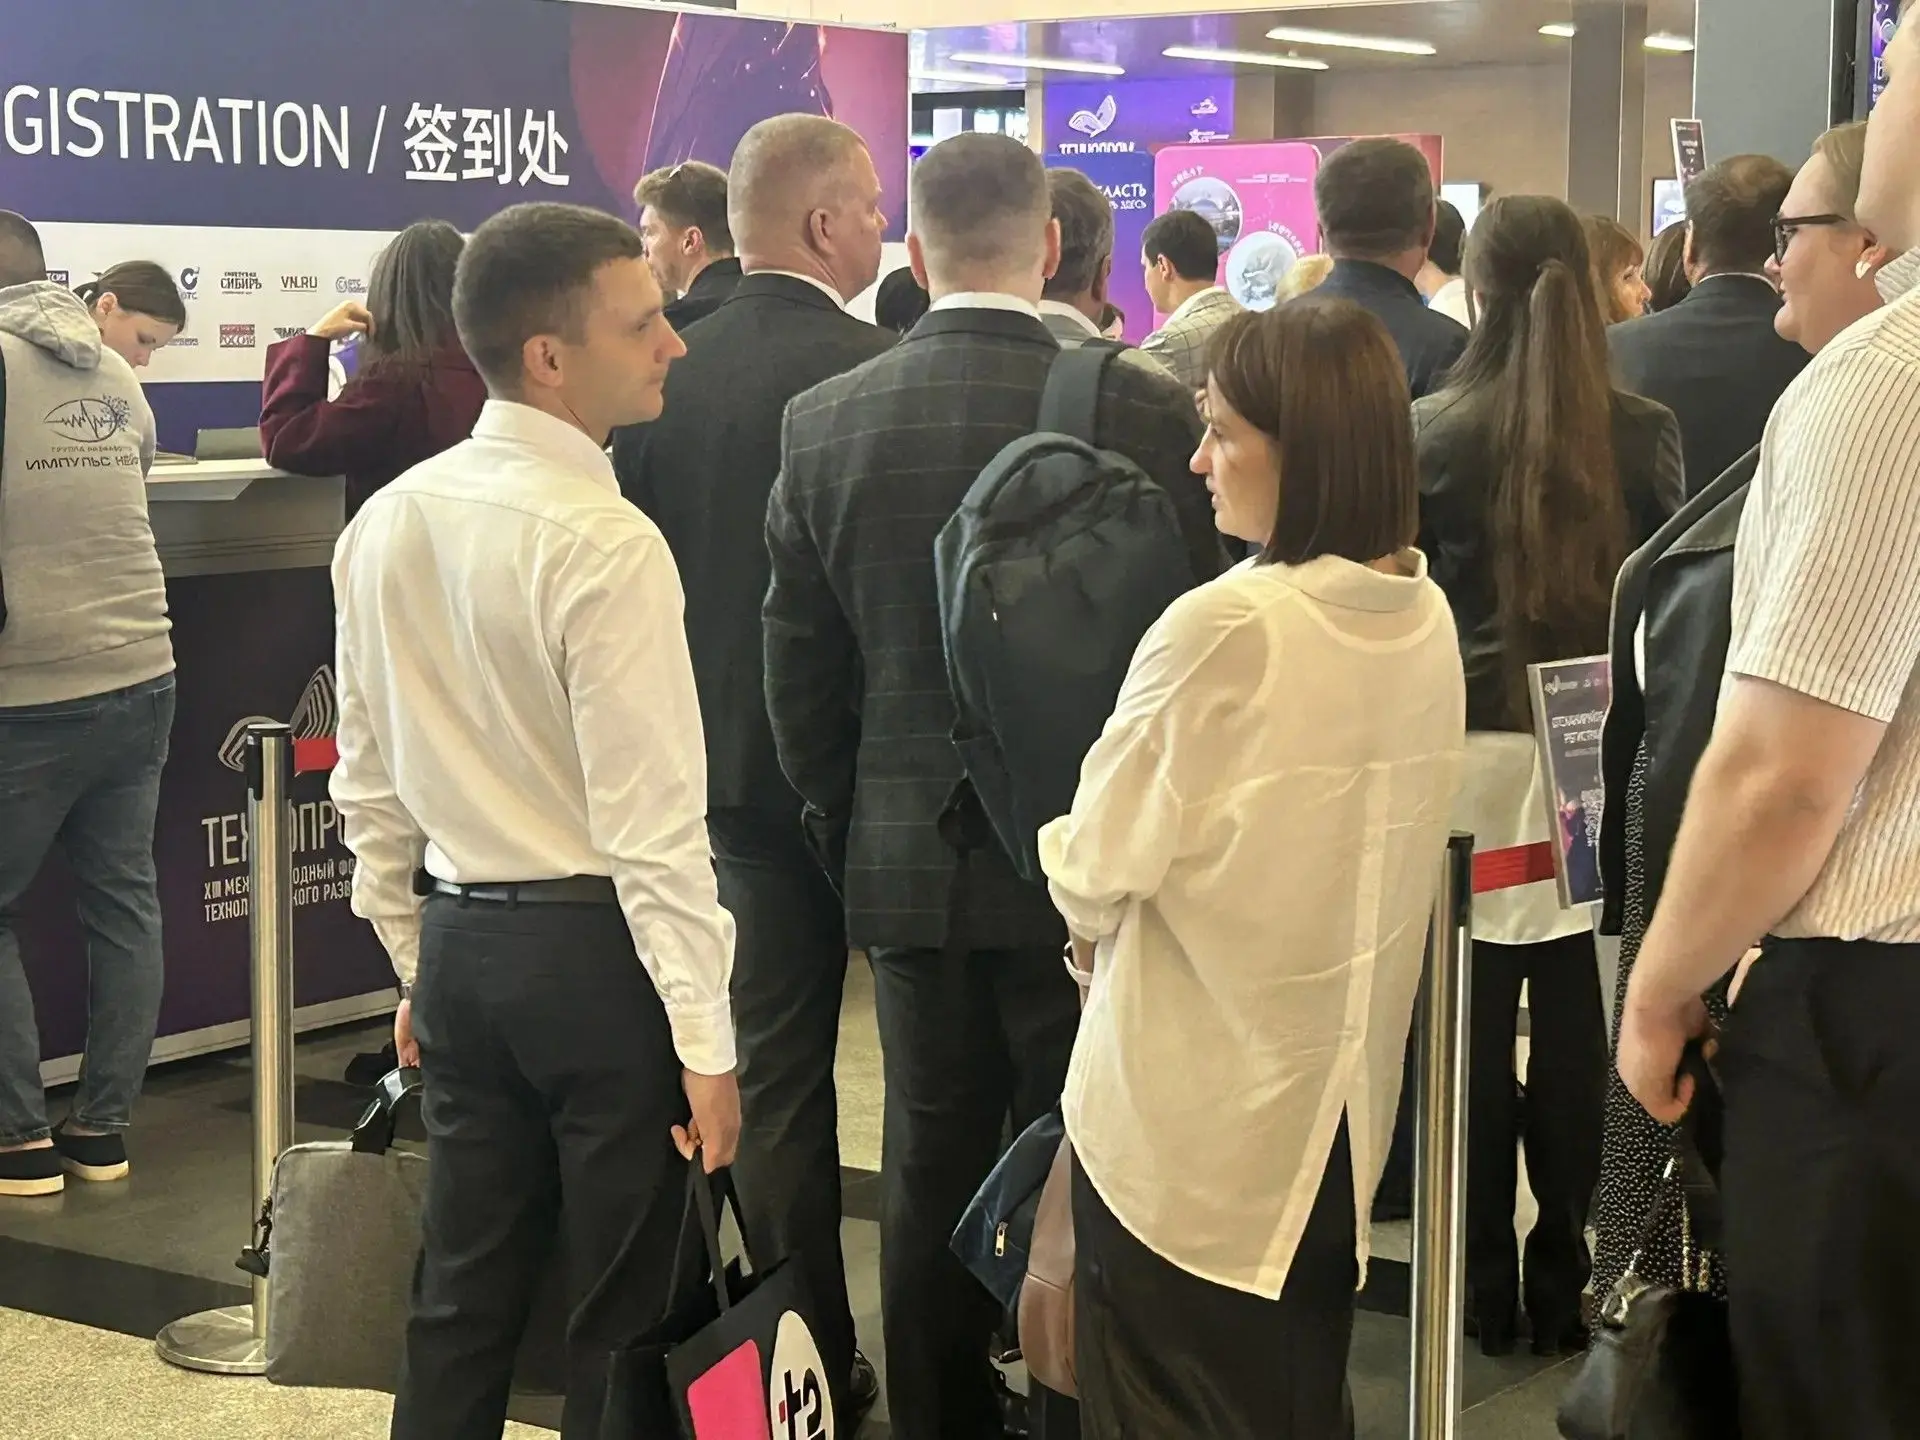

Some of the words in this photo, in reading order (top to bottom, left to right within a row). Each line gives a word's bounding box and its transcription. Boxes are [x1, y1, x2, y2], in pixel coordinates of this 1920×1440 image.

[3, 84, 349, 169] GISTRATION
[367, 105, 387, 174] /
[403, 102, 570, 187] 签到处
[1097, 183, 1147, 198] ЛАСТЬ
[220, 278, 262, 289] СИБИРЬ
[280, 276, 318, 288] VN.RU
